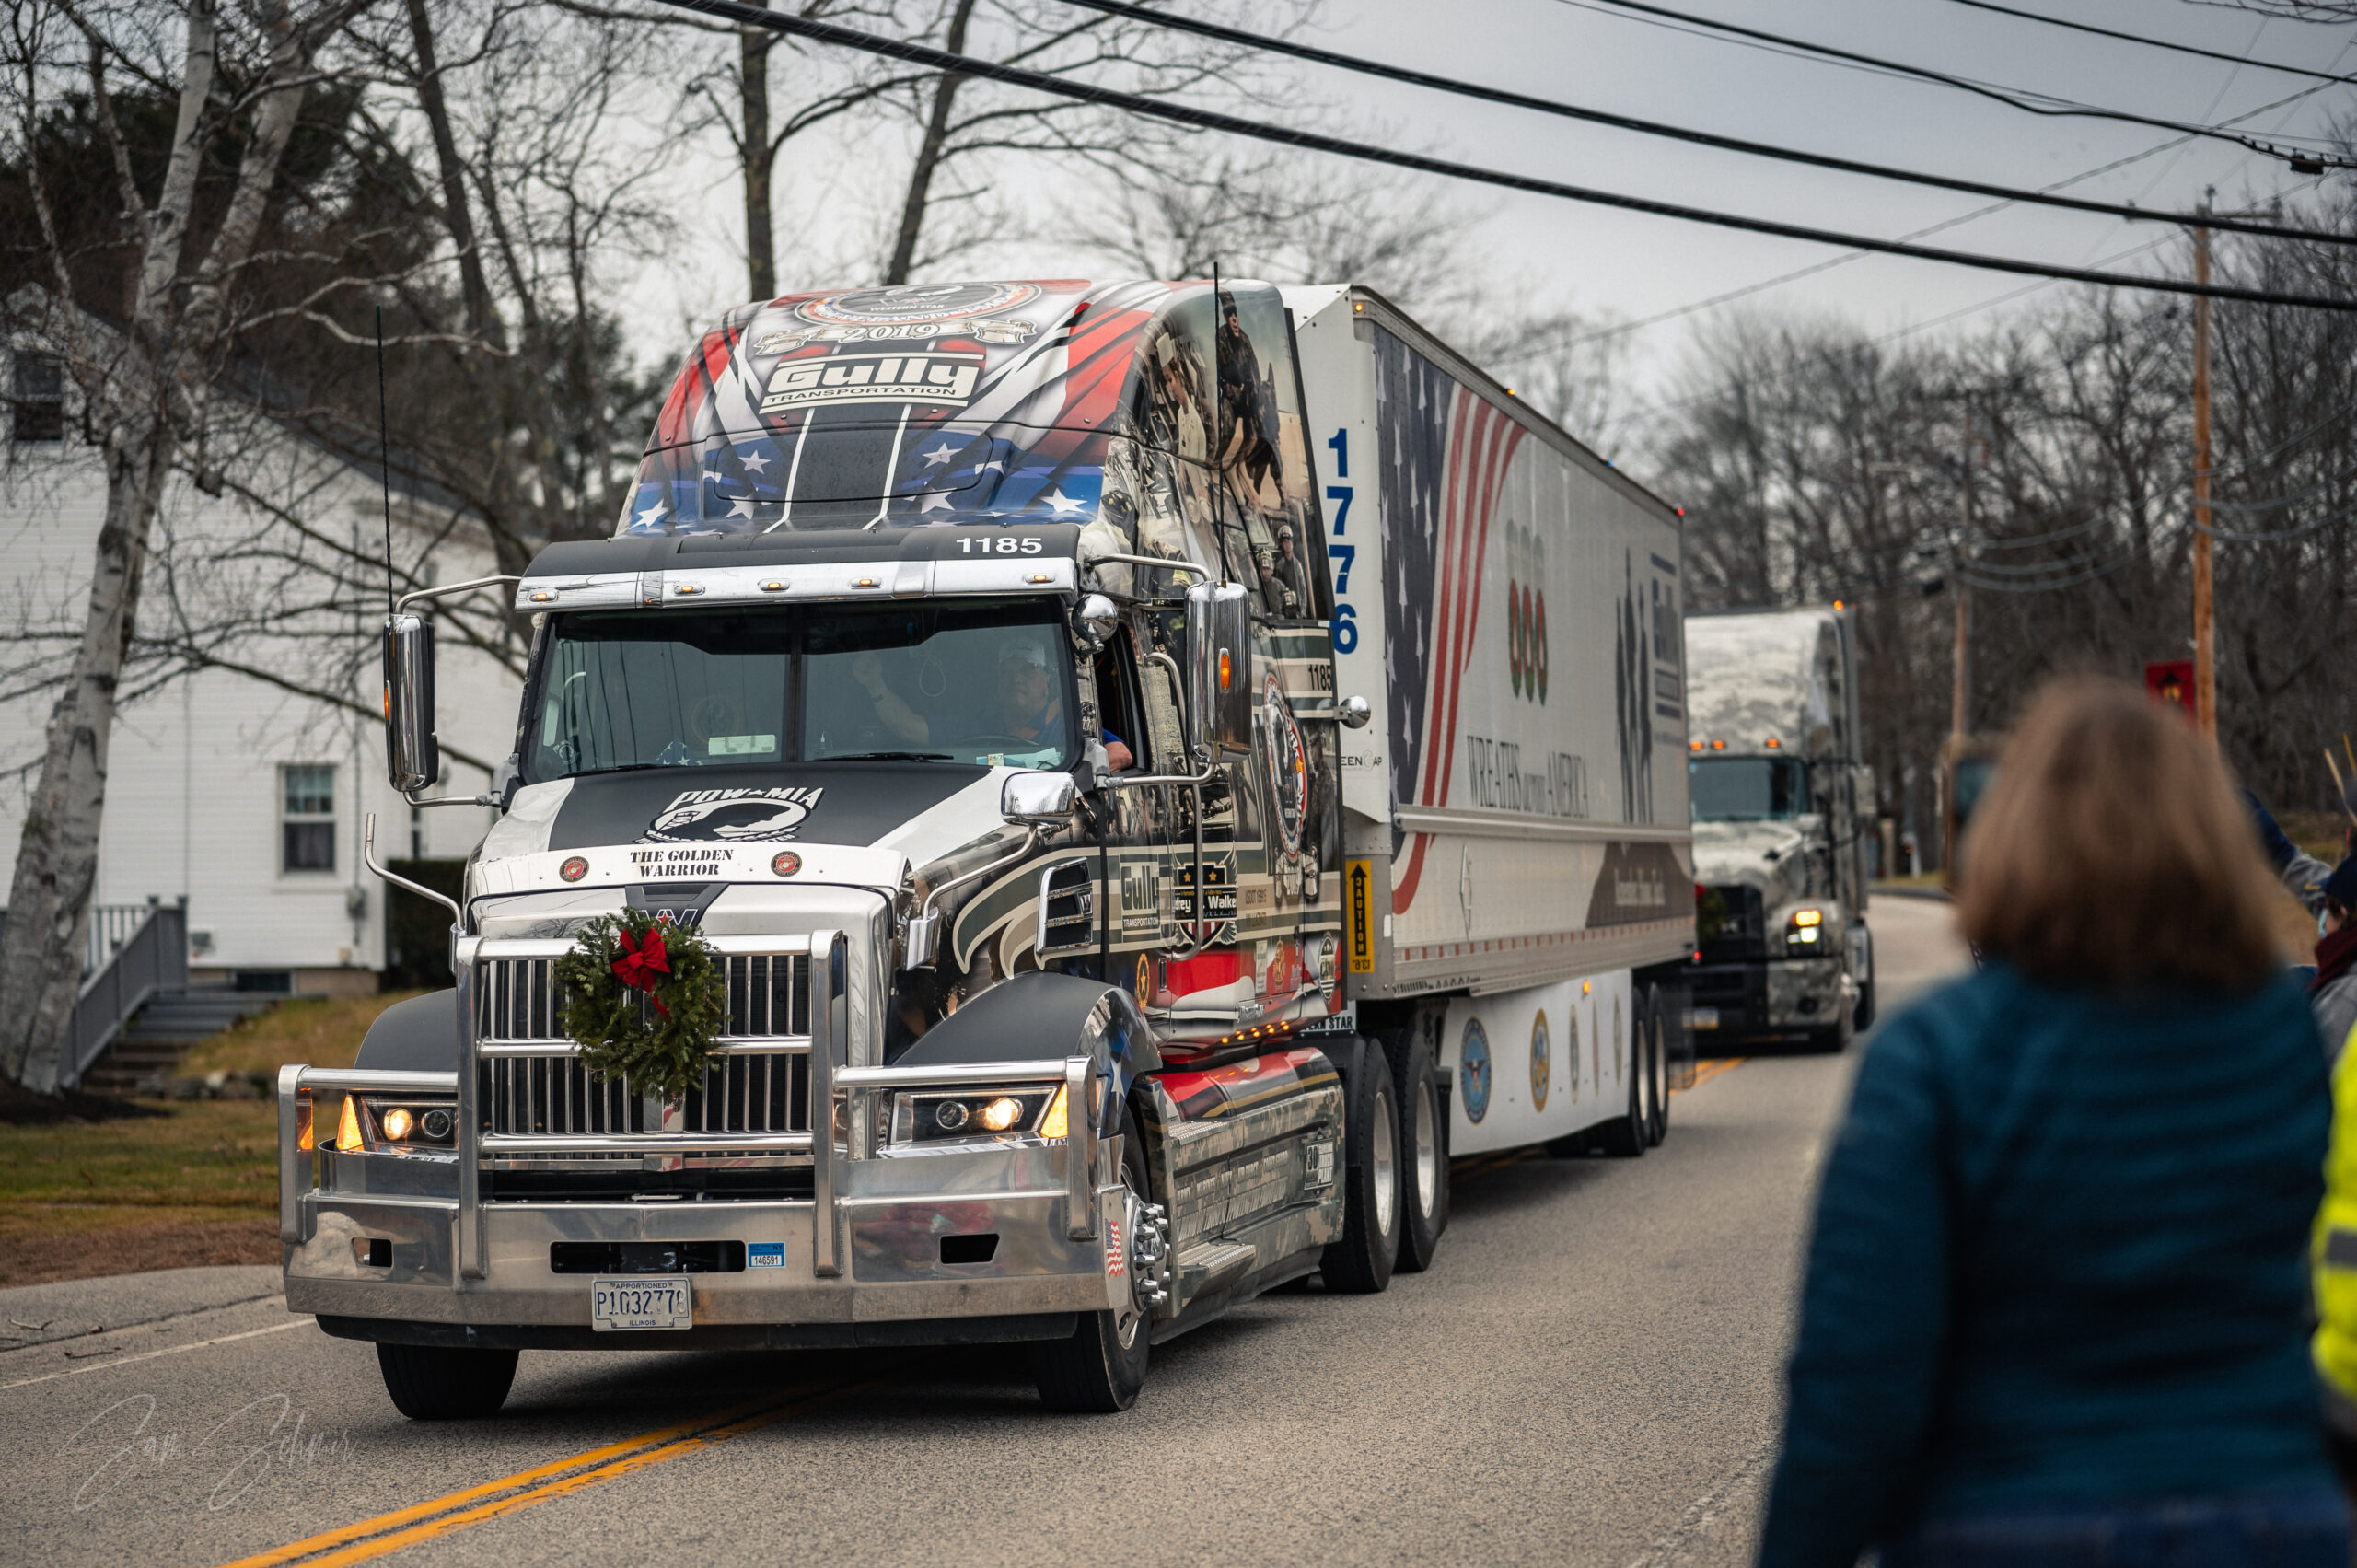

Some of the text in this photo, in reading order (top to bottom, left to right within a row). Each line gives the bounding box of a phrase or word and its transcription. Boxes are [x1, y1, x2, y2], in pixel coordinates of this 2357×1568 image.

[839, 322, 940, 343] 2019
[768, 357, 981, 399] Gully
[769, 386, 956, 403] TRANSPORTATION
[957, 537, 1042, 554] 1185
[1326, 427, 1359, 655] 1776
[1307, 664, 1332, 691] 1185
[1467, 735, 1521, 811] WREATHS
[662, 787, 824, 814] POW MIA
[630, 849, 735, 864] THE GOLDEN
[639, 864, 720, 877] WARRIOR
[1121, 865, 1159, 910] Gully
[1207, 894, 1237, 909] Walke
[1123, 916, 1159, 928] TRANSPORTATION
[1329, 1016, 1353, 1029] STAR
[1307, 1145, 1318, 1170] 30
[754, 1255, 778, 1265] 146591
